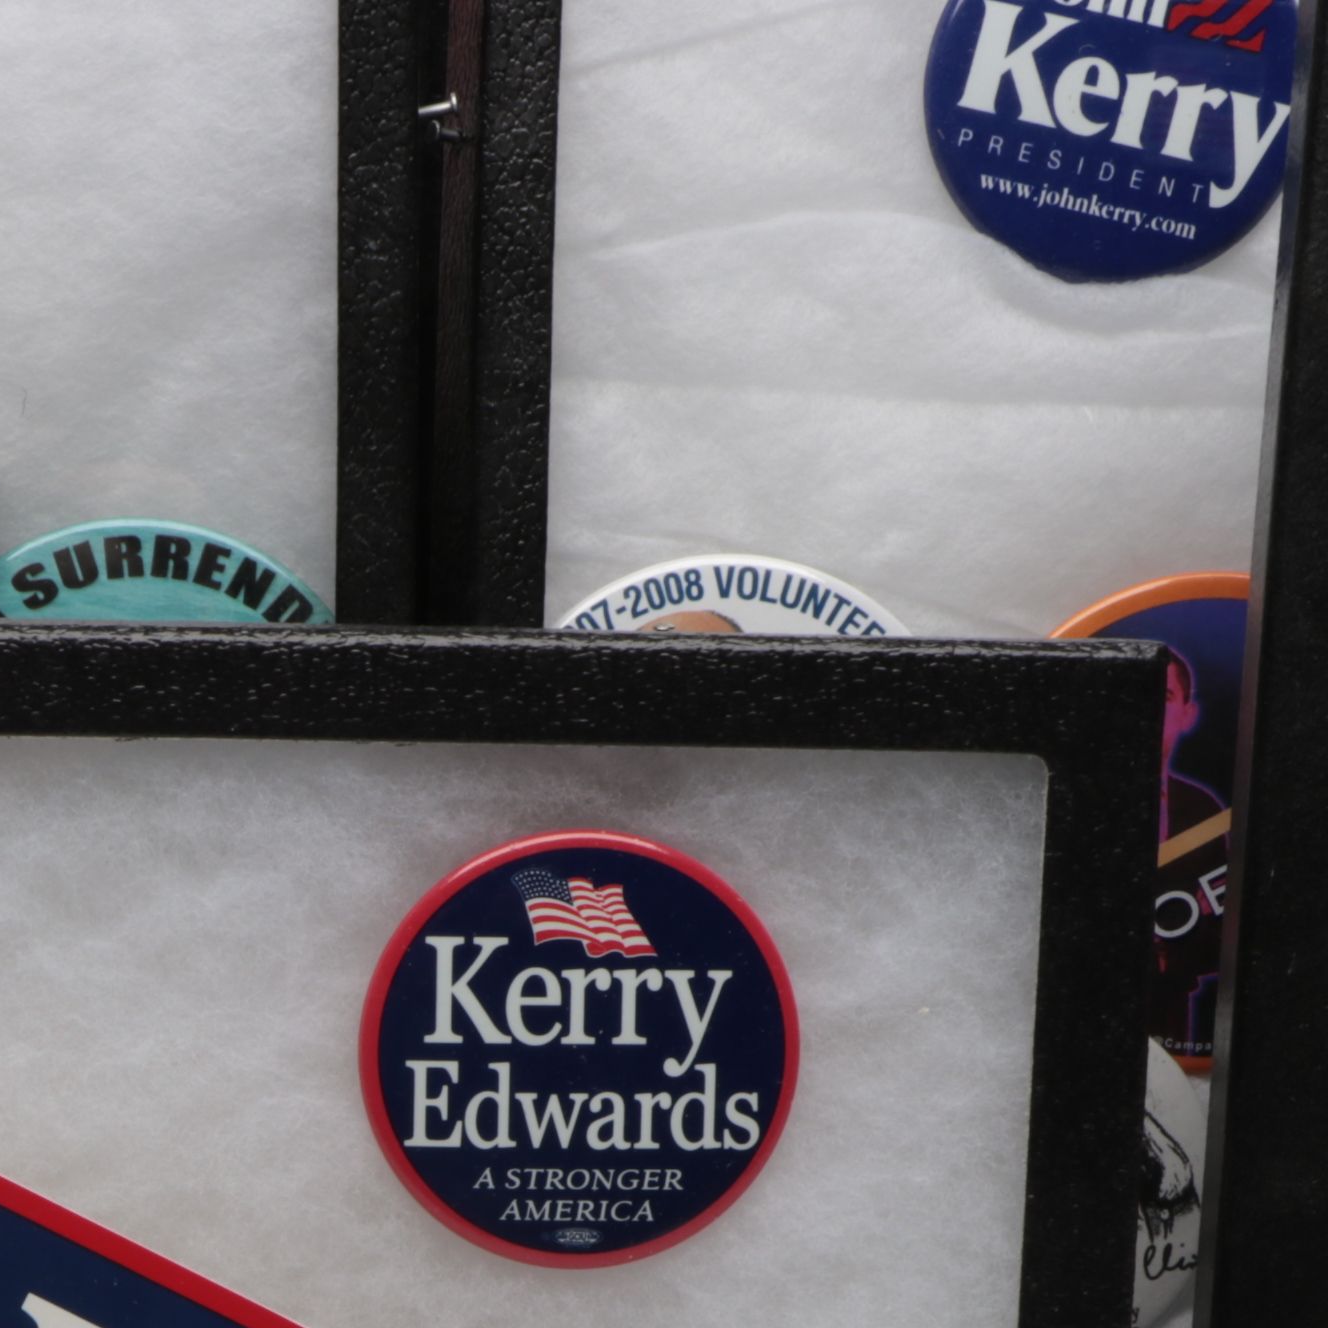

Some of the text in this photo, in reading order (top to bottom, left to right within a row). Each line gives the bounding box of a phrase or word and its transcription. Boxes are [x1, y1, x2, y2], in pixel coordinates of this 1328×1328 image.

[957, 0, 1290, 208] Kerry
[958, 129, 1205, 204] PRESIDENT
[979, 172, 1197, 240] www.johnkerry.com
[11, 533, 314, 623] SURREND
[564, 568, 705, 631] 07-2008
[423, 936, 733, 1078] Kerry
[403, 1060, 761, 1152] Edwards
[472, 1167, 684, 1191] A STRONGER
[499, 1199, 655, 1222] AMERICA
